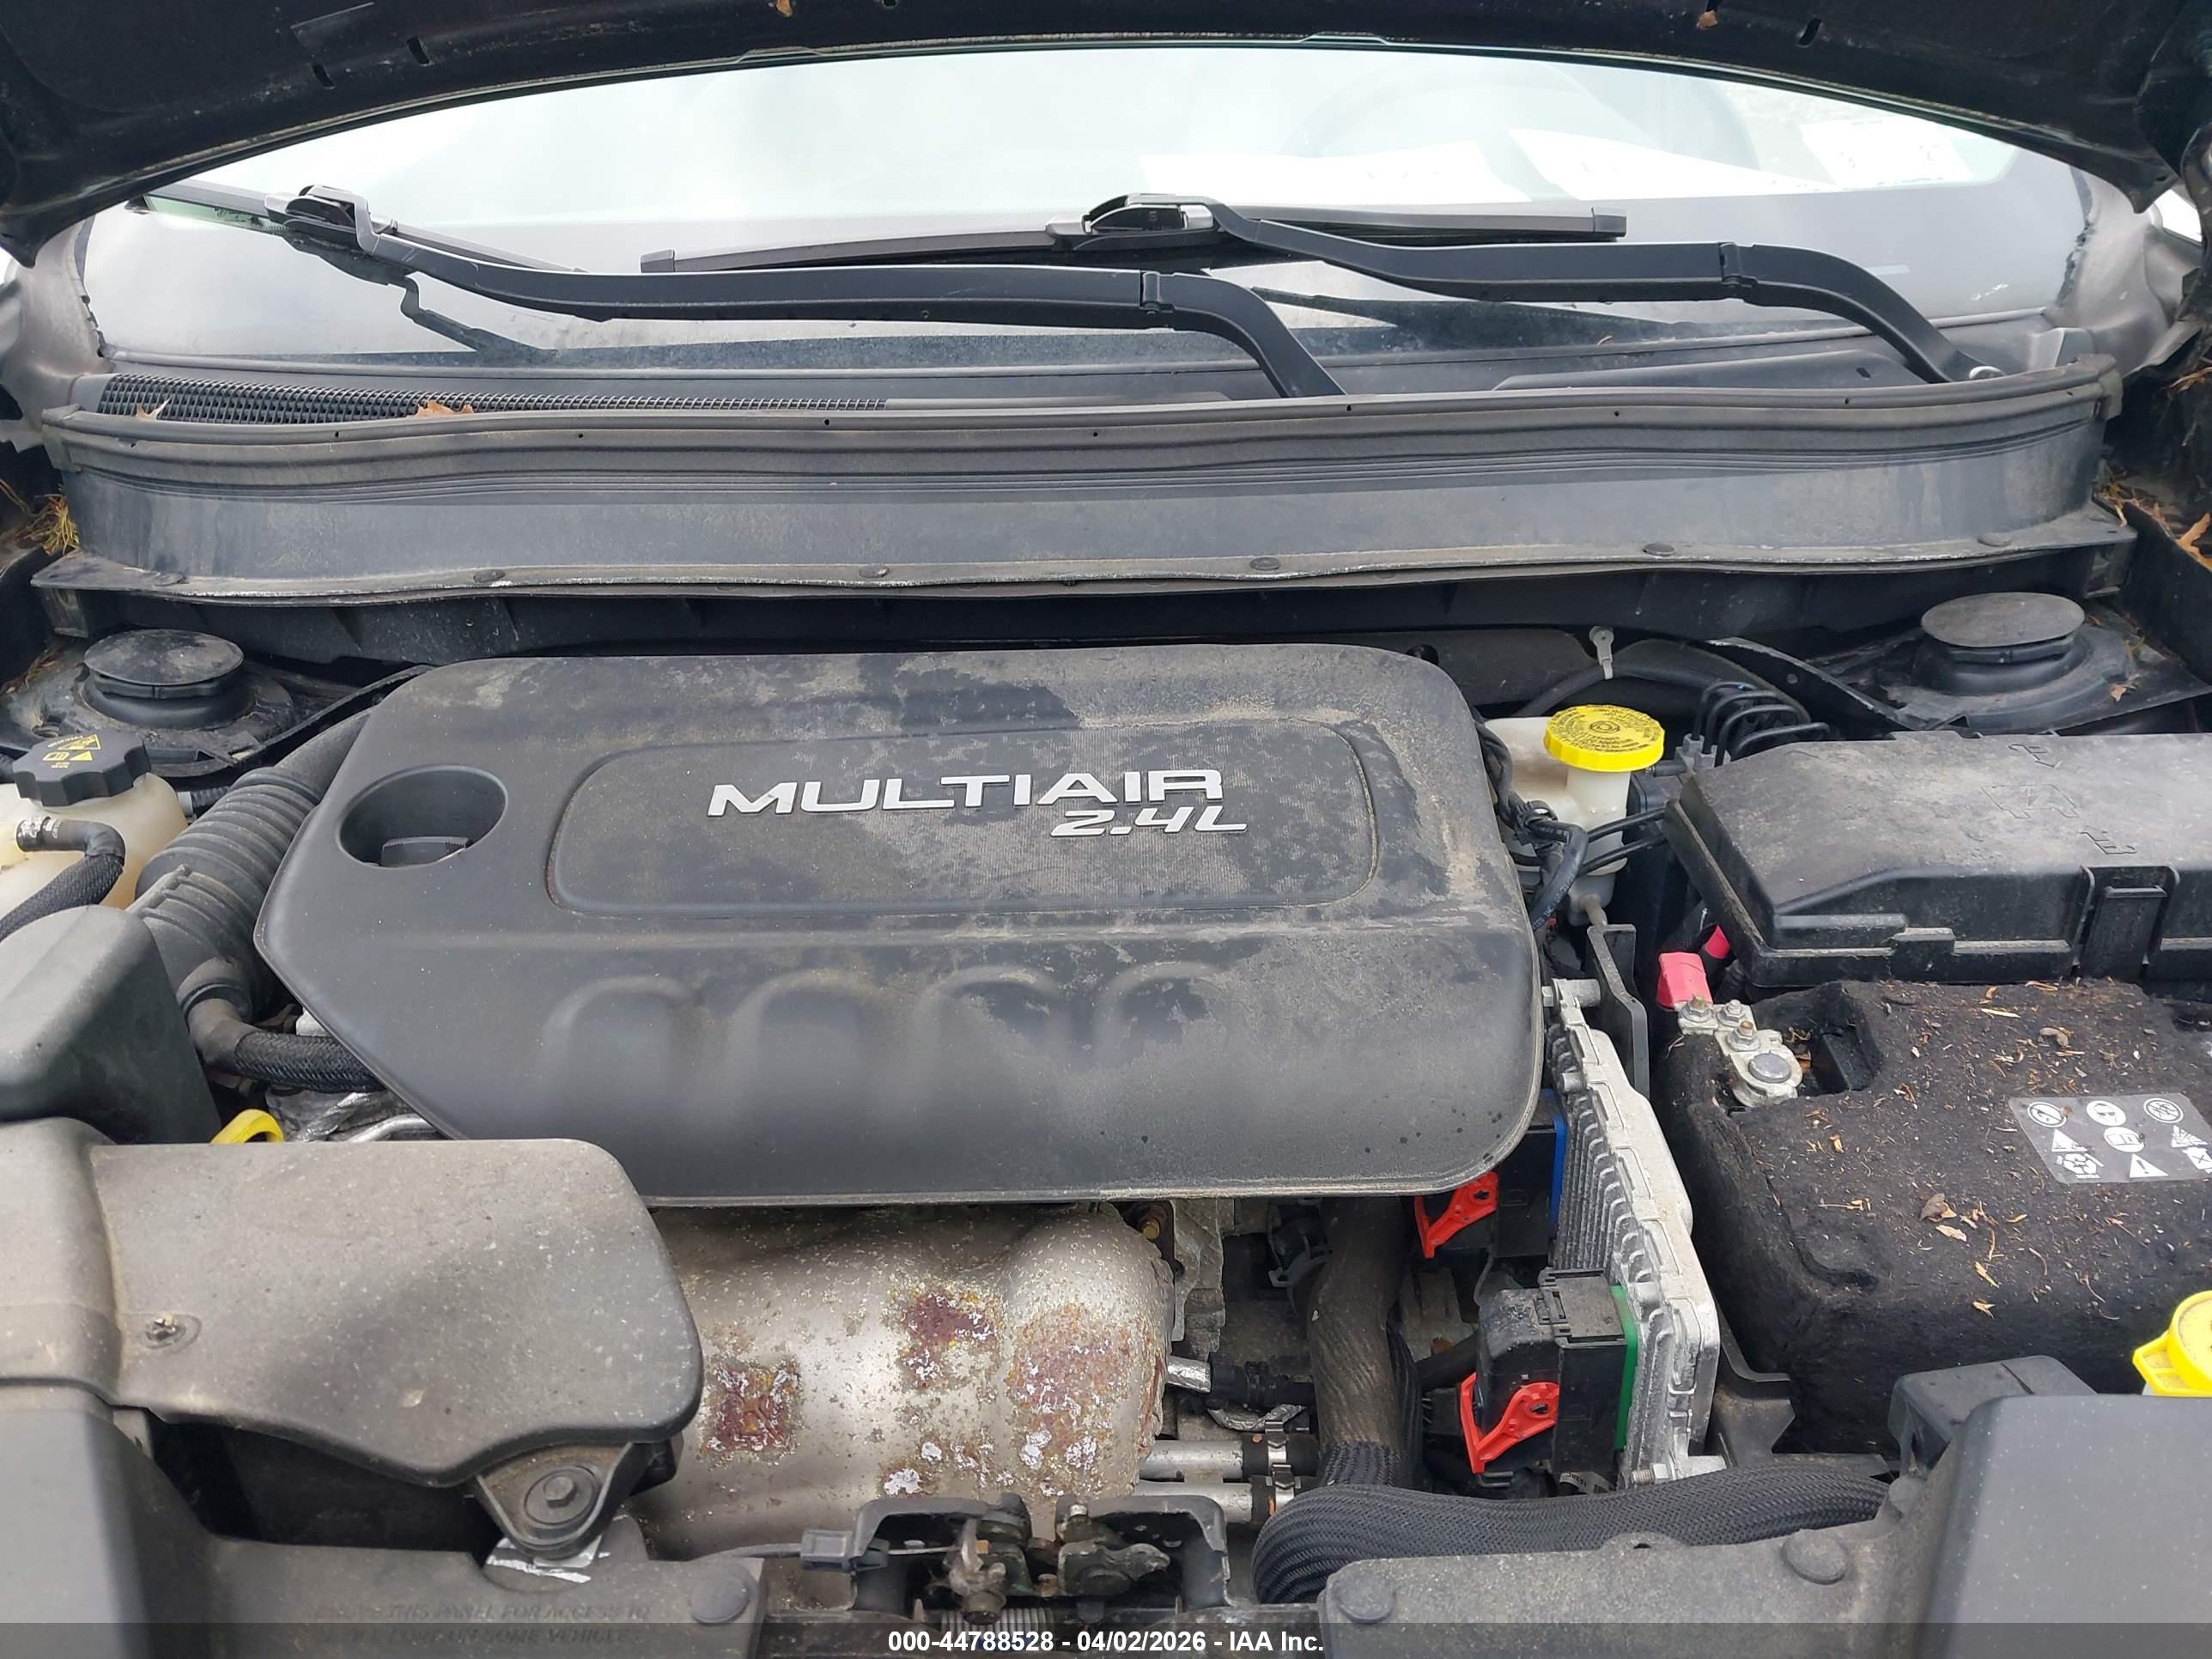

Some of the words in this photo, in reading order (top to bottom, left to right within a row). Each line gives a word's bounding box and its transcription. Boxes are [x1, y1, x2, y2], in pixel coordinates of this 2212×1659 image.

[707, 769, 1223, 817] MULTIAIR
[1050, 805, 1248, 837] 2.4L
[501, 1604, 541, 1621] FOR
